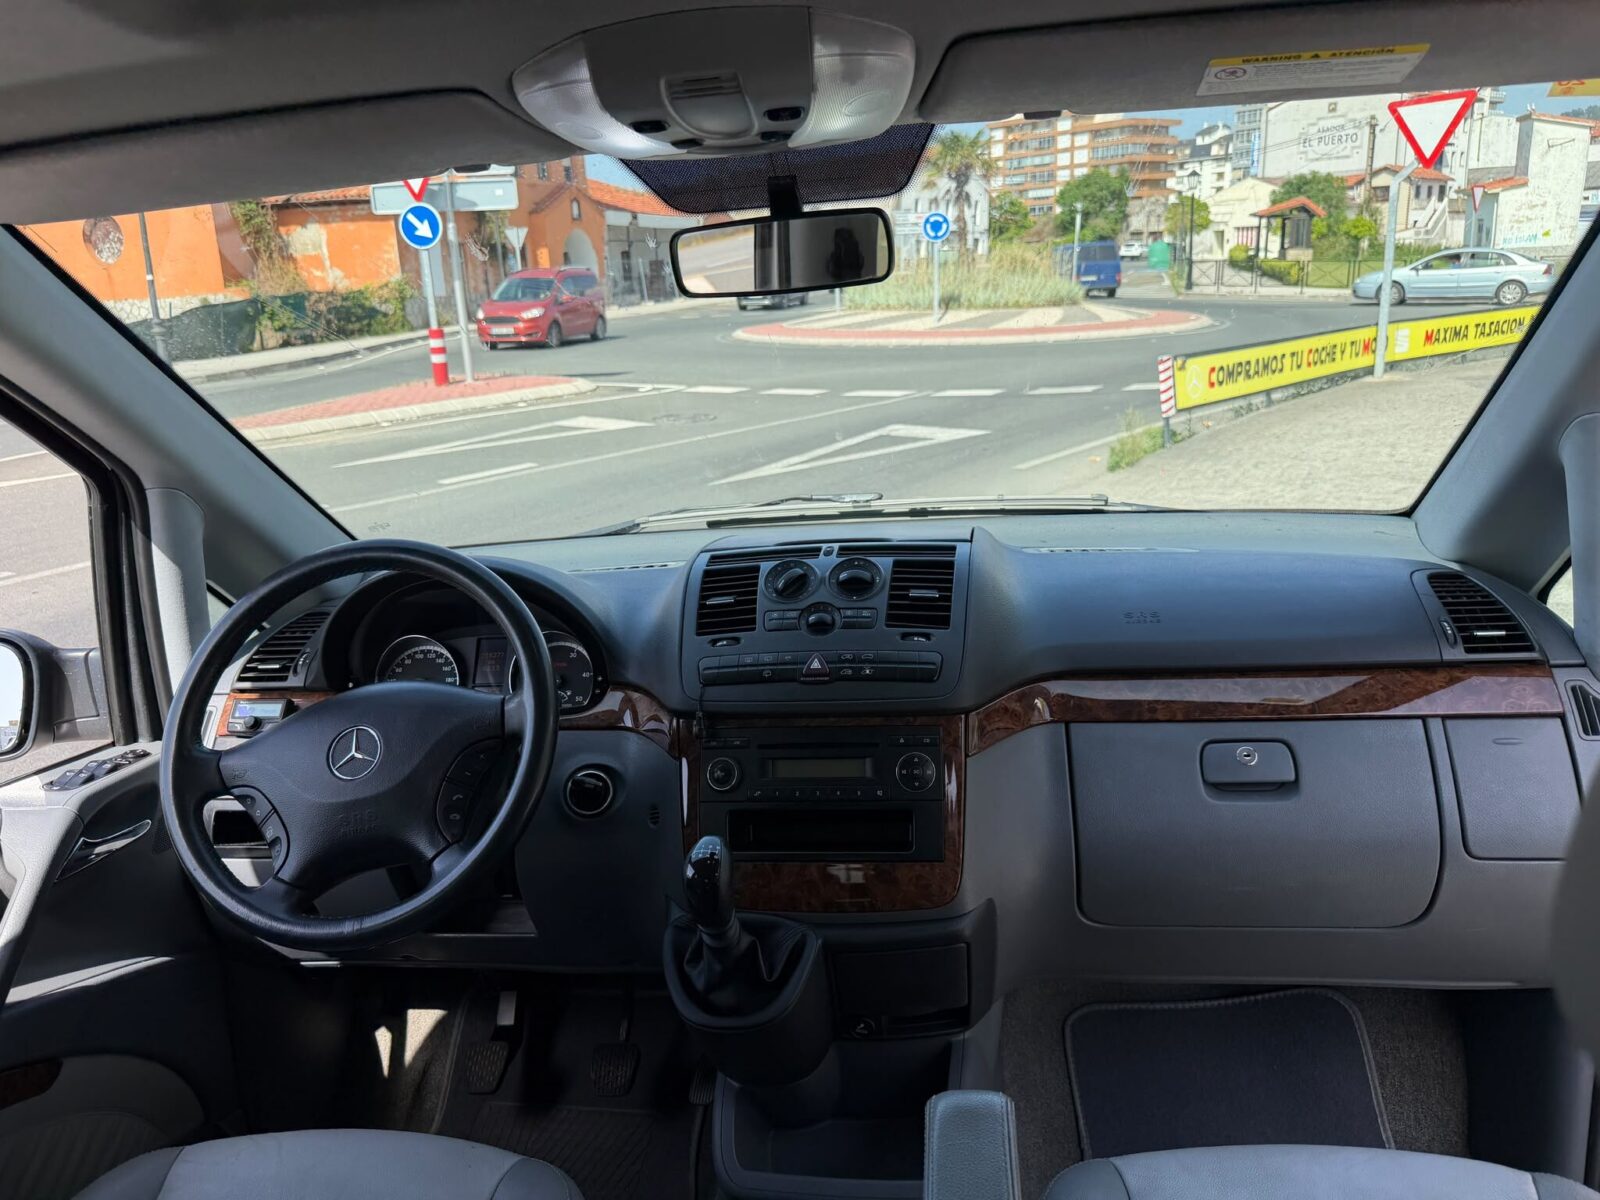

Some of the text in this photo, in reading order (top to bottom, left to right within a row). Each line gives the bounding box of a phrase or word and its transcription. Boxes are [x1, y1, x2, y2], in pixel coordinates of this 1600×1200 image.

[1241, 55, 1302, 64] WARNING
[1302, 132, 1358, 148] EL PUERTO
[1423, 324, 1469, 347] MAXIMA
[1208, 353, 1285, 389] COMPRAMOS
[1289, 350, 1304, 372] TU
[1306, 344, 1336, 369] COCHE
[1339, 342, 1347, 361] Y
[1348, 339, 1361, 359] TU
